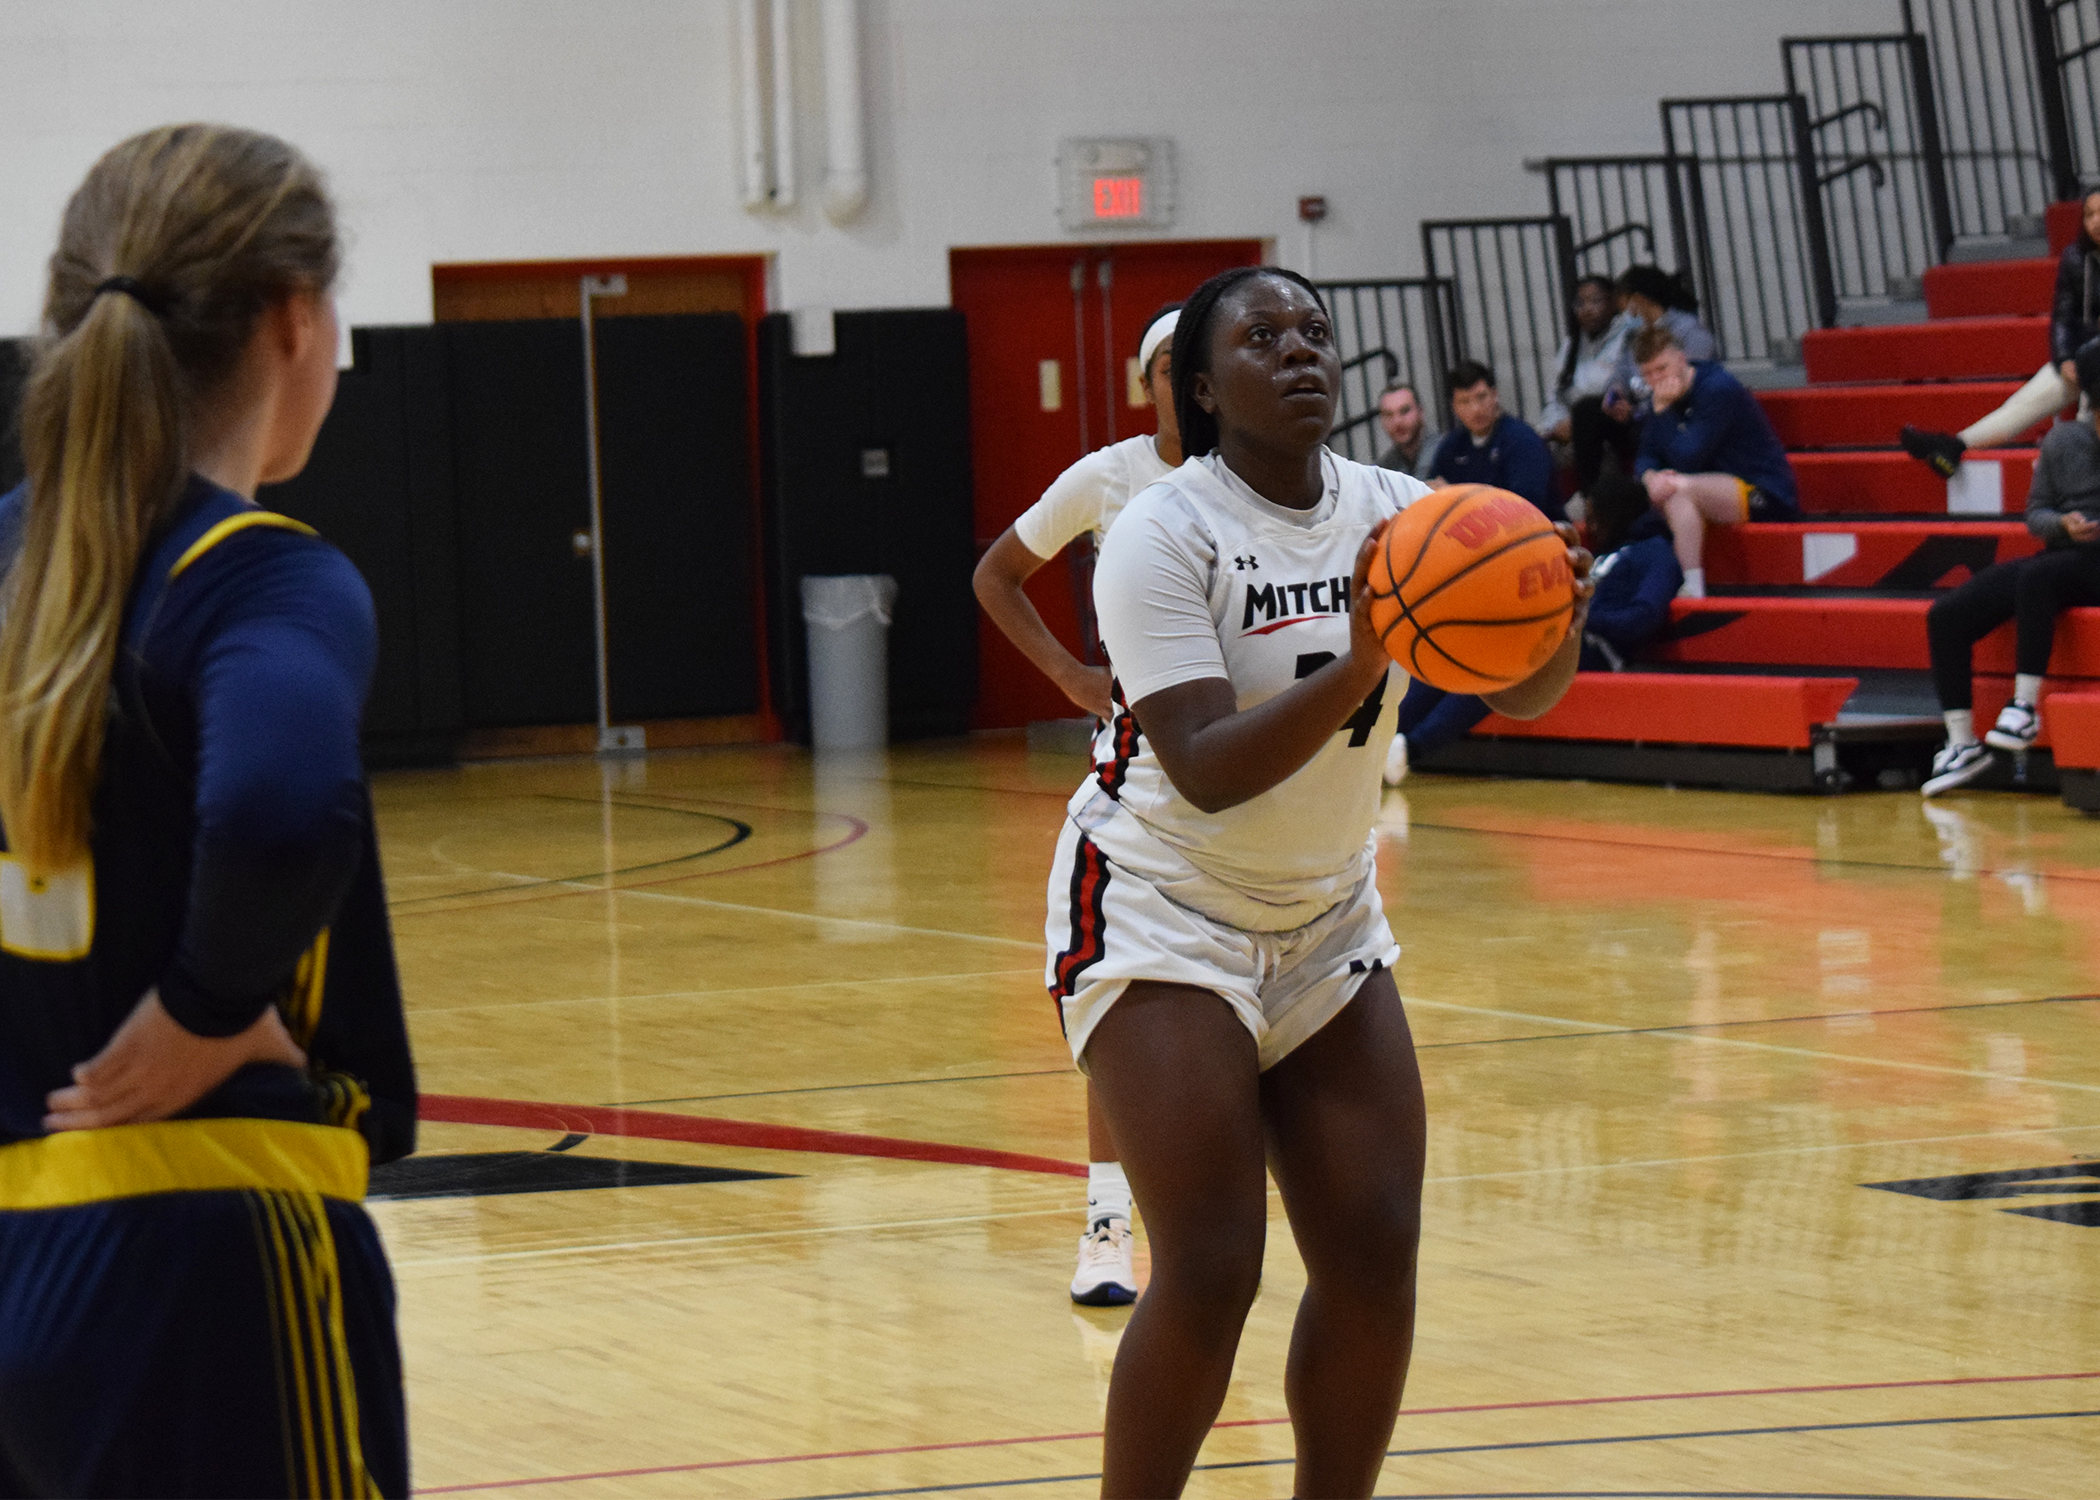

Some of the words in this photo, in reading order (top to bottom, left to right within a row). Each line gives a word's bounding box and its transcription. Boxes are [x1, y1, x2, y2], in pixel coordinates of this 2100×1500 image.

[1094, 178, 1140, 216] EXIT
[1518, 554, 1573, 600] EV
[1242, 575, 1351, 630] MITCH
